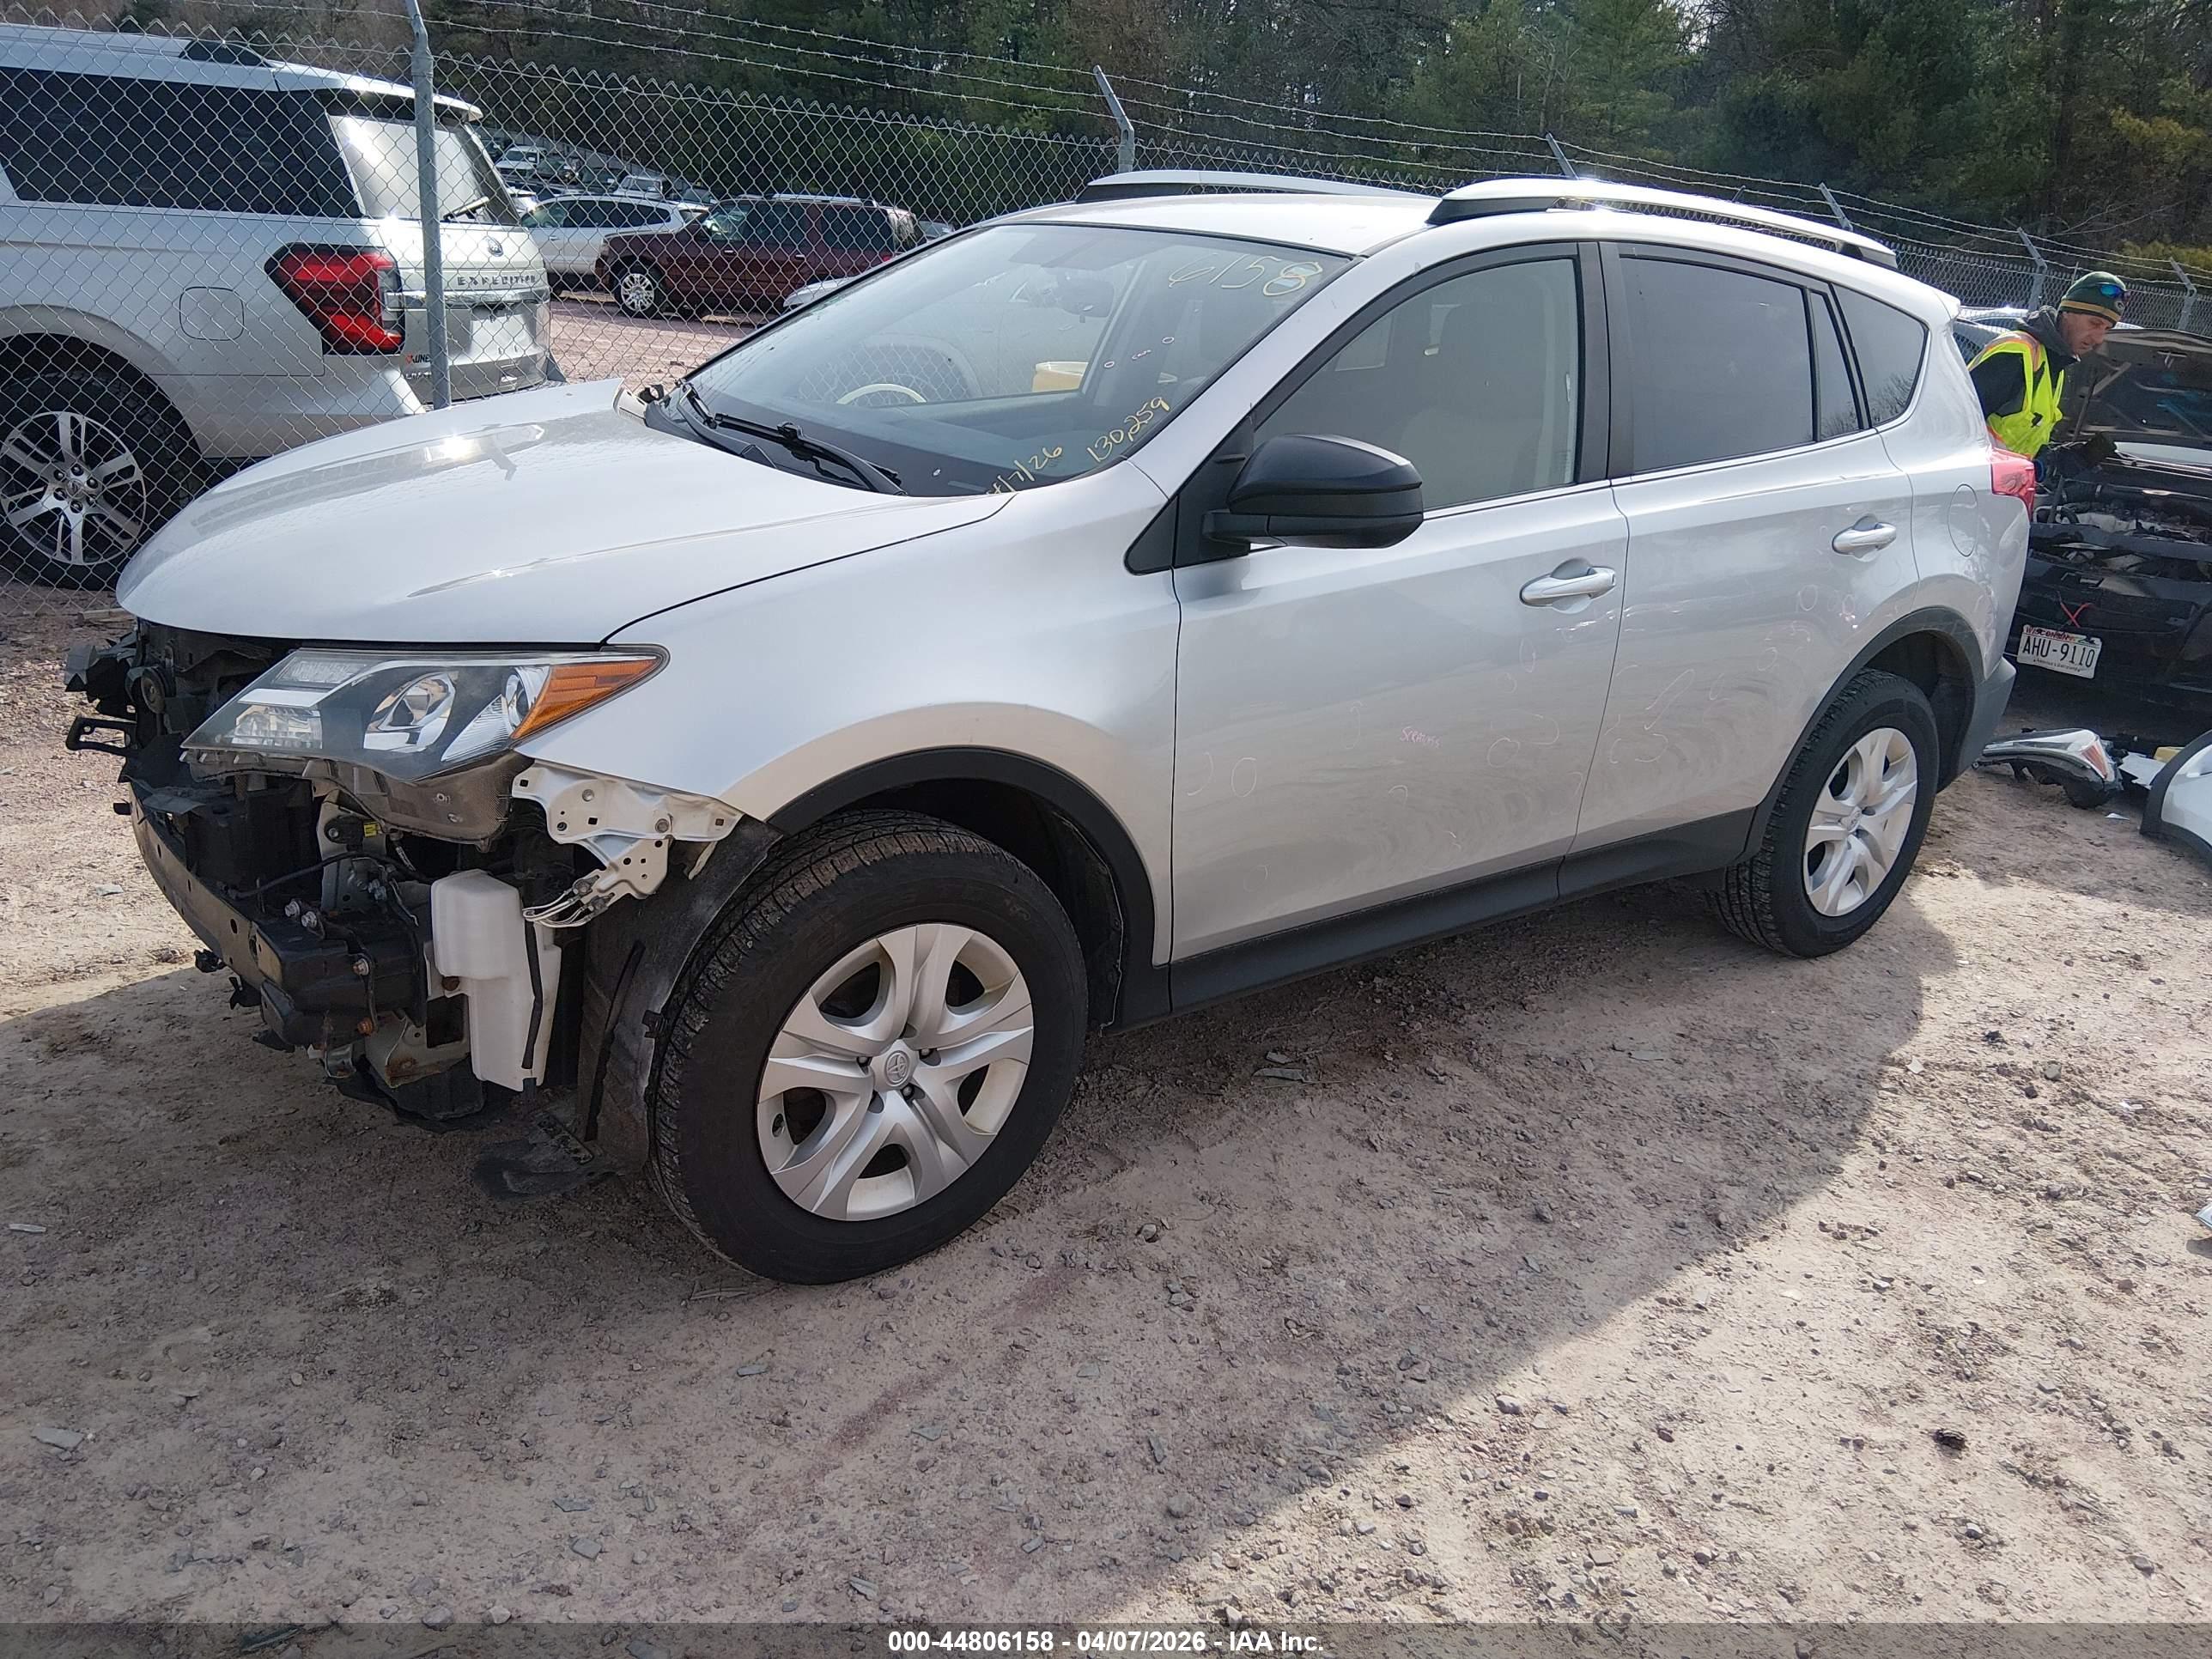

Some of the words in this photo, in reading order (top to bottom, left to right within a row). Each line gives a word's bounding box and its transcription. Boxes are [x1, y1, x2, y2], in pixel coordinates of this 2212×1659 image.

[1169, 252, 1323, 296] 6158
[1086, 397, 1170, 463] 130,259
[2022, 635, 2096, 668] AHU-9110
